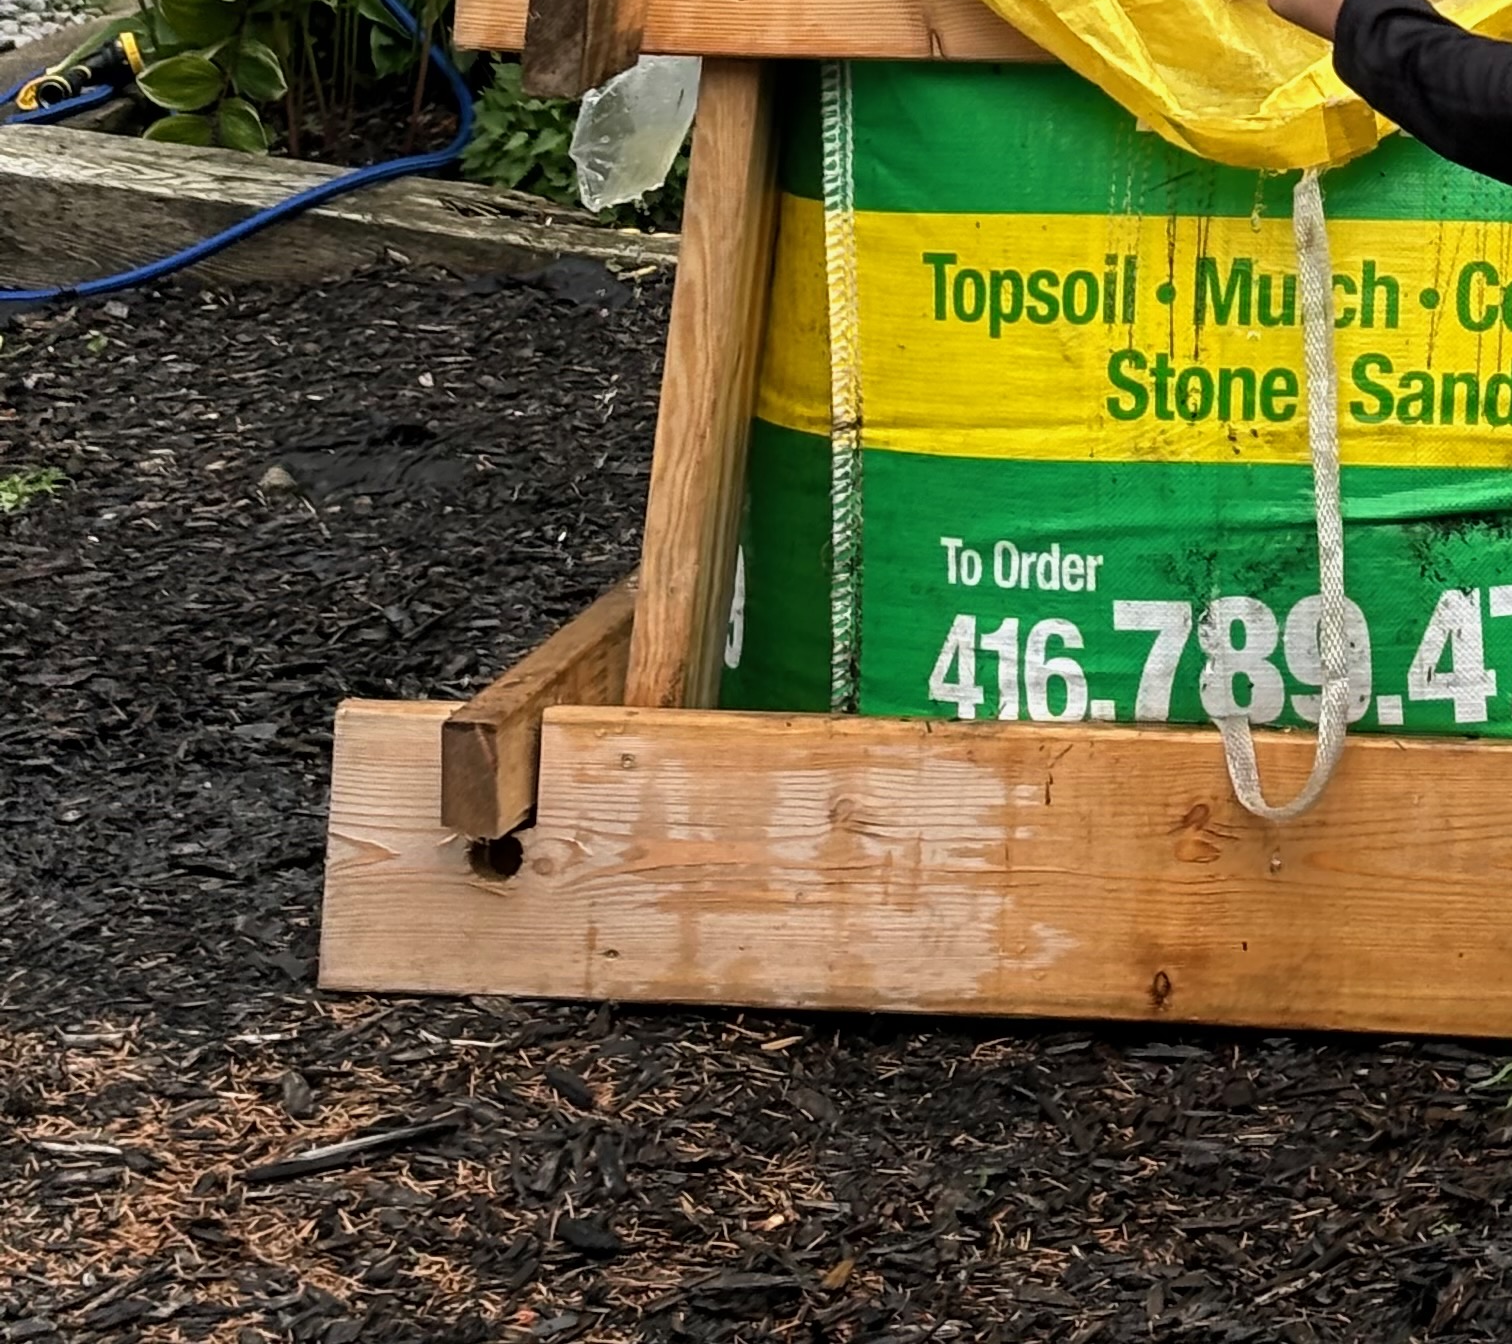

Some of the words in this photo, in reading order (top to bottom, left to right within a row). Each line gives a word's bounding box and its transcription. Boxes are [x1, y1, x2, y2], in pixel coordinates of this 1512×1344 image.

[922, 252, 1136, 338] Topsoil
[1194, 256, 1400, 329] Much
[1106, 348, 1299, 423] Stone
[940, 537, 982, 586] To
[994, 540, 1104, 592] Order
